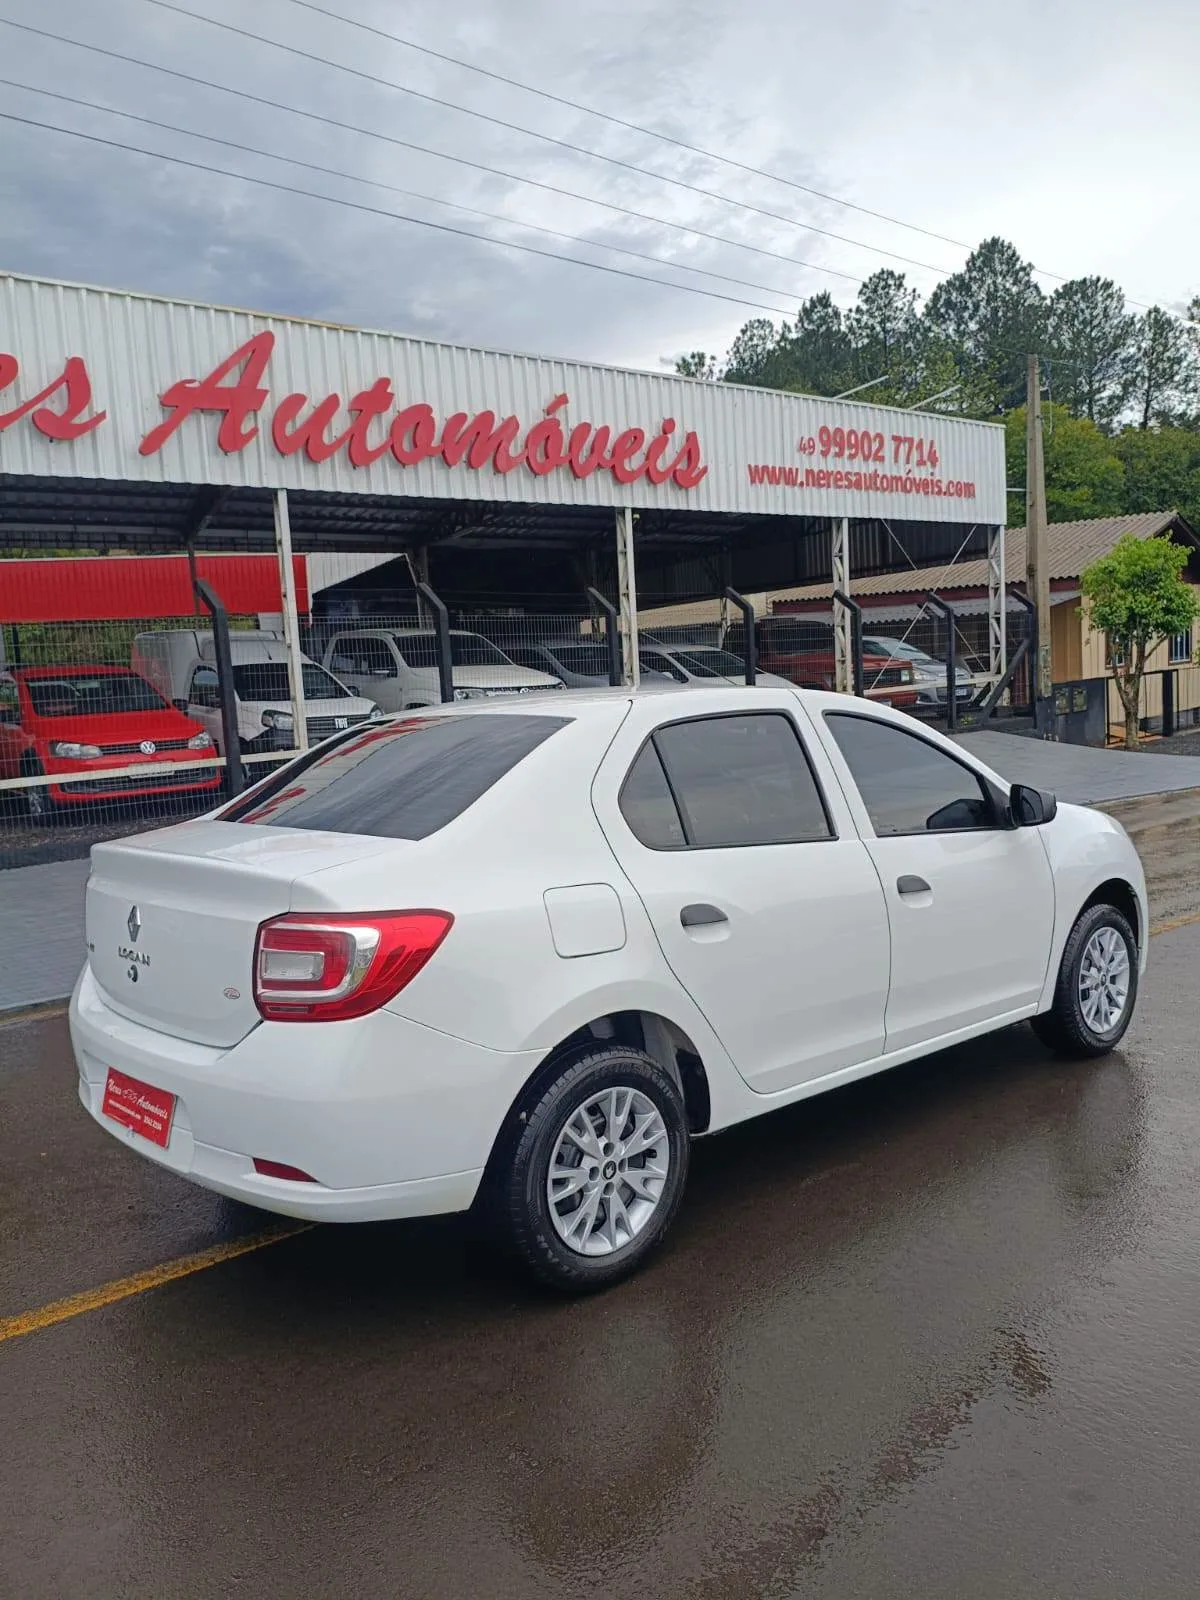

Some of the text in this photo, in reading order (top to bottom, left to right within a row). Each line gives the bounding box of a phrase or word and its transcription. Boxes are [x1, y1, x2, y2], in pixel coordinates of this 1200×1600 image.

[139, 330, 707, 489] Automóveis
[799, 425, 939, 469] 49 99902 7714
[747, 463, 977, 499] www.neresautomóveis.com
[118, 945, 151, 967] LOGAN
